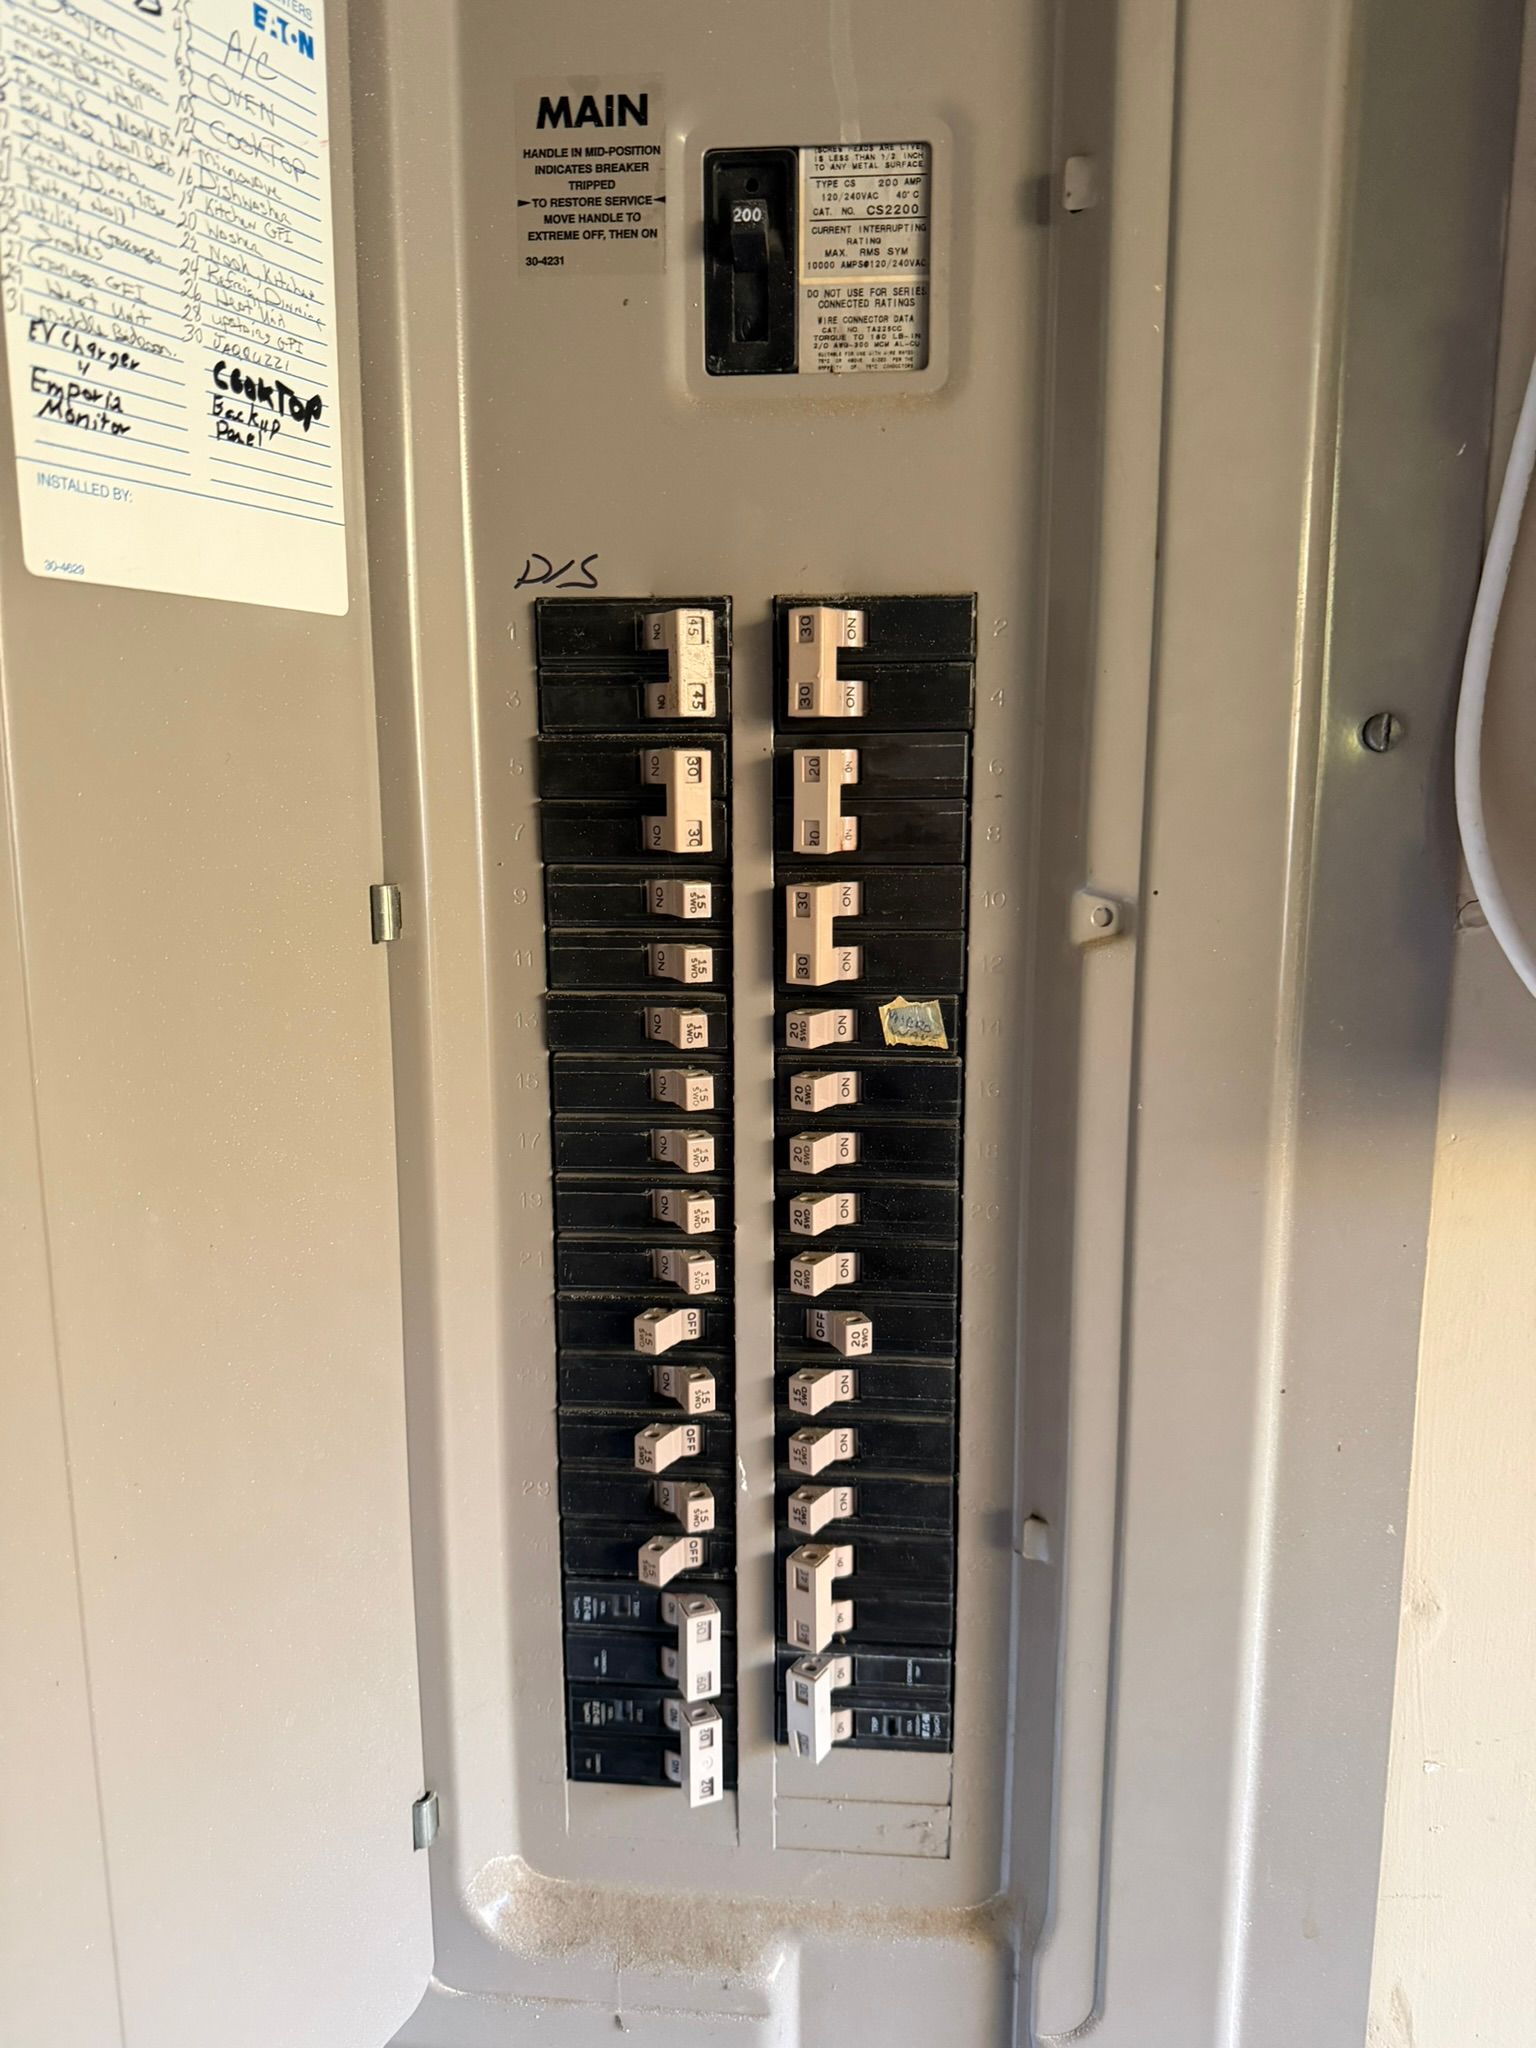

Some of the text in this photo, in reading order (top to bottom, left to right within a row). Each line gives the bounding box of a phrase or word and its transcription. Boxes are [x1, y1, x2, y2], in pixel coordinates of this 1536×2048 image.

[535, 93, 648, 129] MAIN
[523, 145, 661, 159] HANDLE IN MID-POSITION
[828, 153, 849, 162] LESS
[855, 153, 876, 161] THAN
[904, 151, 924, 160] INCH
[534, 162, 649, 175] INDICATES BREAKER
[814, 160, 924, 172] TO ANY METAL SURFACE
[568, 180, 616, 190] TRIPPED
[816, 177, 922, 189] TYPE CS 200 AMP
[532, 195, 653, 208] TO RESTORE SERVICE
[821, 191, 879, 202] 120/240VAC
[543, 212, 641, 225] MOVE HANDLE TO
[733, 207, 762, 223] 200
[813, 204, 919, 216] CAT. NO. CS2200
[527, 228, 658, 241] EXTREME OFF, THEN ON
[811, 224, 927, 235] CURRENT INTERRUPTING
[846, 237, 882, 245] RATING
[525, 256, 564, 266] 30-4231
[824, 247, 909, 257] MAX. RMS SYM
[807, 261, 835, 270] 10000
[807, 286, 927, 298] DO NOT USE FOR SERIES
[817, 298, 916, 309] CONNECTED RATINGS
[817, 314, 914, 325] WIRE CONNECTOR DATA
[29, 319, 57, 344] EV
[813, 334, 846, 342] TORQUE
[36, 472, 133, 503] INSTALLED BY:
[652, 622, 661, 640] ON
[687, 618, 699, 638] 45
[800, 615, 811, 638] 30
[846, 617, 856, 640] ON
[657, 694, 666, 710] ON
[691, 690, 705, 711] 45
[800, 685, 811, 707] 30
[846, 686, 856, 709] ON
[651, 756, 660, 777] ON
[688, 756, 700, 776] 30
[808, 758, 820, 777] 20
[653, 825, 662, 846] ON
[688, 828, 701, 847] 30
[656, 887, 664, 908] ON
[697, 894, 706, 909] 15
[842, 886, 851, 907] ON
[657, 950, 665, 971] ON
[699, 959, 707, 974] 15
[797, 956, 809, 976] 30
[842, 951, 851, 972] ON
[654, 1013, 662, 1035] ON
[790, 1022, 799, 1039] 20
[838, 1015, 847, 1035] ON
[794, 1085, 804, 1102] 20
[841, 1077, 850, 1097] ON
[794, 1147, 803, 1163] 20
[840, 1137, 849, 1157] ON
[661, 1196, 669, 1216] ON
[661, 1255, 669, 1276] ON
[840, 1259, 849, 1278] ON
[794, 1270, 803, 1286] 20
[687, 1311, 697, 1336] OFF
[816, 1311, 826, 1338] OFF
[851, 1331, 860, 1347] 20
[841, 1375, 849, 1394] ON
[794, 1387, 802, 1402] 15
[686, 1428, 696, 1451] OFF
[839, 1433, 848, 1452] ON
[839, 1492, 848, 1512] ON
[688, 1540, 698, 1563] OFF
